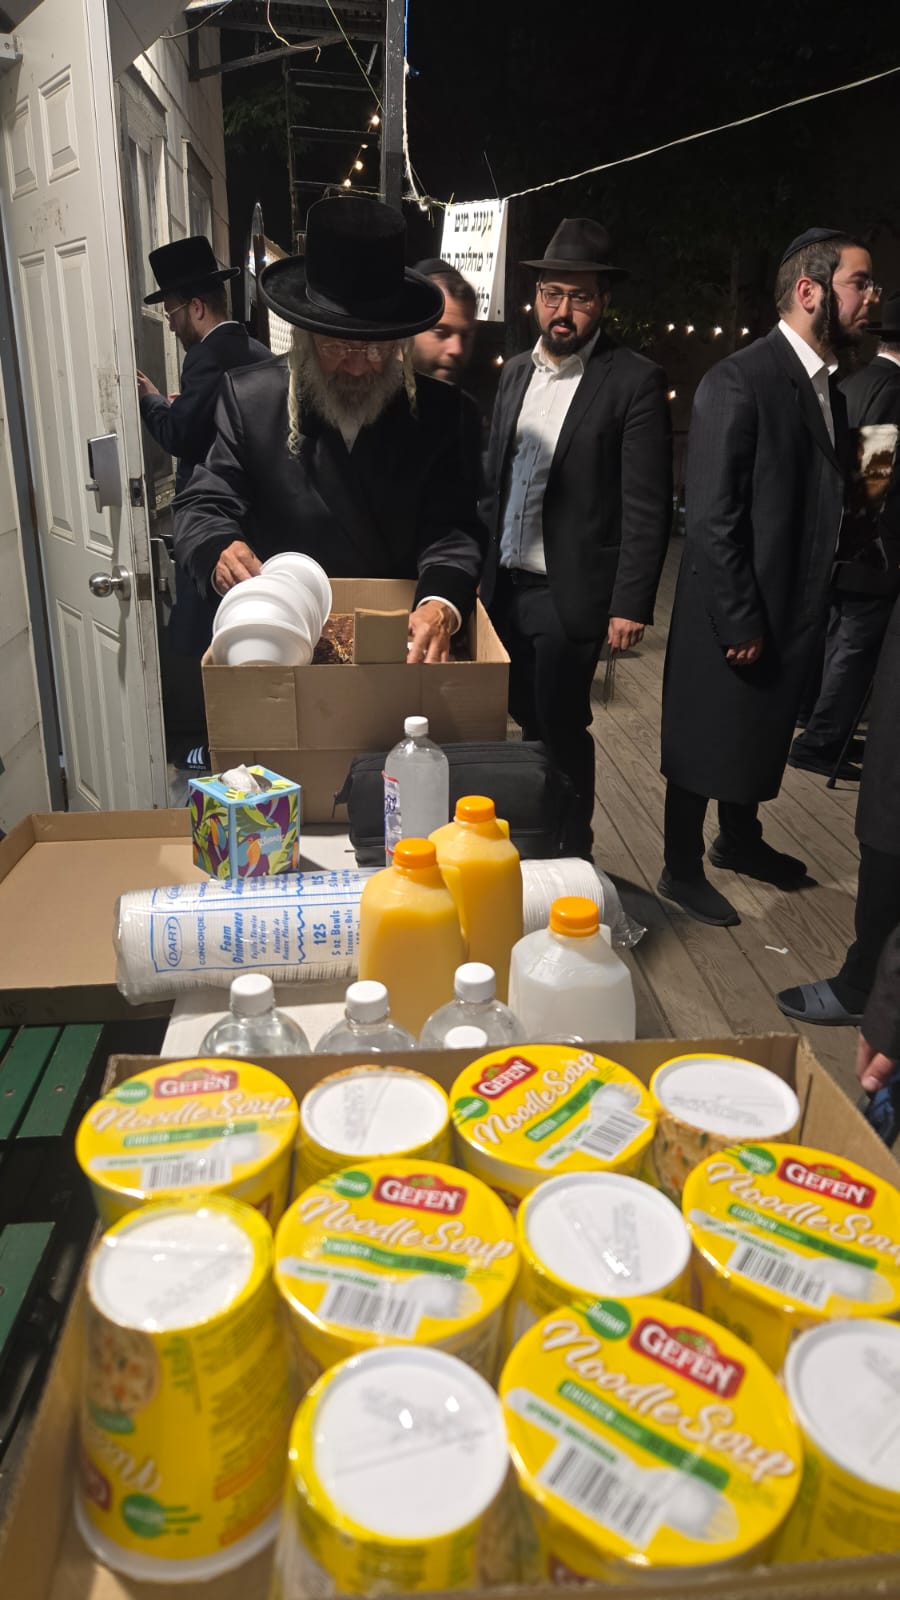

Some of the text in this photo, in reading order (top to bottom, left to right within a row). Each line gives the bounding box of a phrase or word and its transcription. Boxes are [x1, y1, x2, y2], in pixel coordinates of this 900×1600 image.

[454, 212, 470, 232] מיט
[168, 923, 178, 962] DART
[197, 916, 206, 965] CONCORDE
[220, 926, 232, 952] Foam
[231, 912, 244, 964] Dinnerware
[313, 923, 327, 945] 125
[330, 910, 341, 936] Bowls
[333, 940, 341, 949] oz
[159, 1074, 231, 1096] GEFEN
[477, 1060, 532, 1096] GEFEN
[89, 1100, 210, 1133] Noodle
[211, 1091, 292, 1120] Soup
[473, 1088, 555, 1145] Noodle
[543, 1052, 599, 1096] Soup
[379, 1179, 461, 1211] GEFEN
[706, 1160, 831, 1231] Noodle
[785, 1162, 870, 1204] GEFEN
[299, 1194, 423, 1248] Noodle
[422, 1220, 514, 1268] Soup
[638, 1323, 737, 1392] GEFEN
[541, 1318, 682, 1425] Noodle
[678, 1403, 796, 1483] Soup
